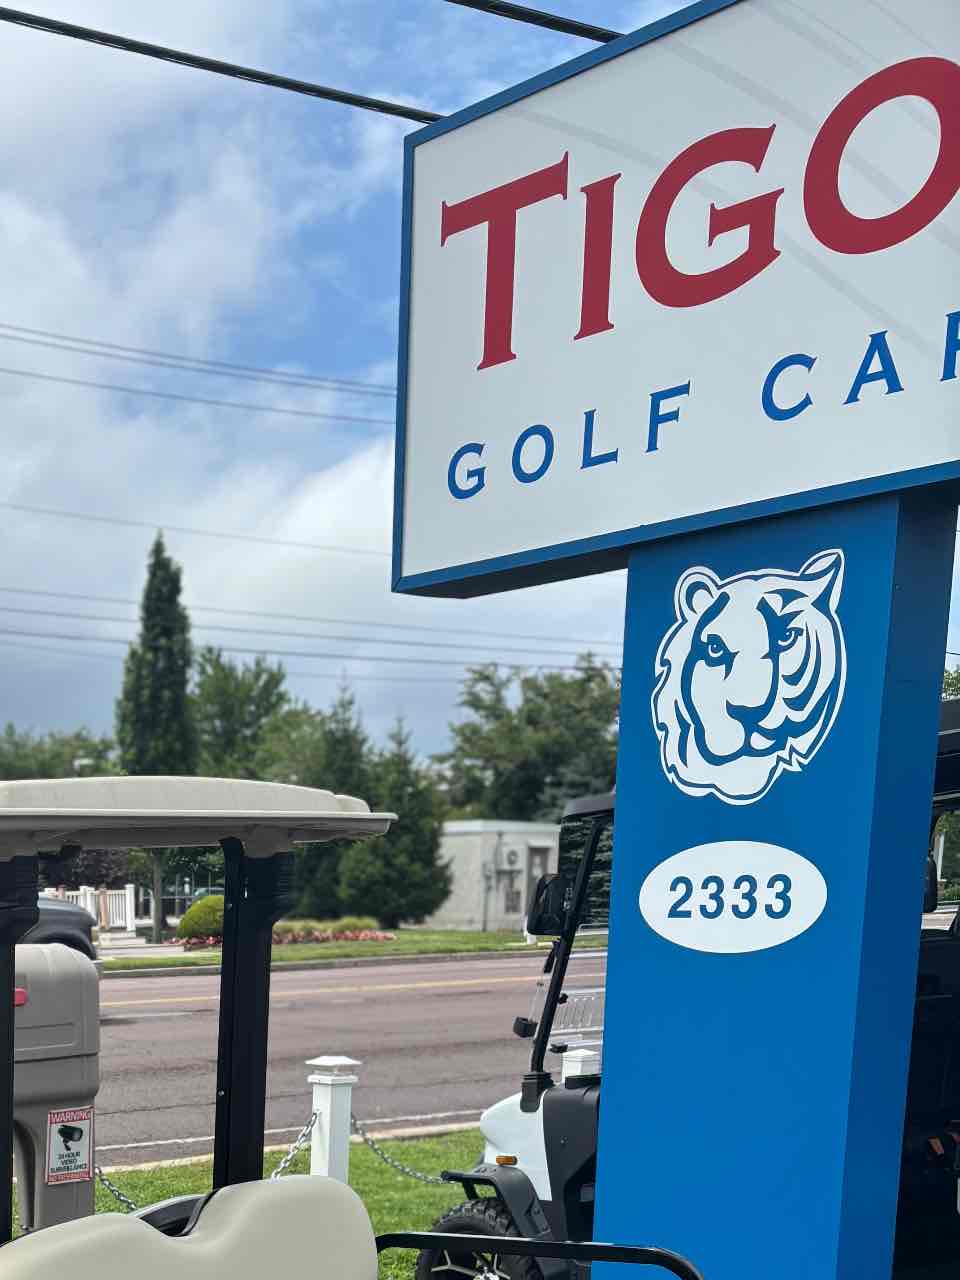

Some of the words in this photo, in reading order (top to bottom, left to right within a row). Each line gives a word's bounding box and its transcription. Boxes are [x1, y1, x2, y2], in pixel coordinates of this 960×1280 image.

[441, 56, 960, 370] TIGO
[447, 380, 691, 500] GOLF
[667, 873, 792, 919] 2333
